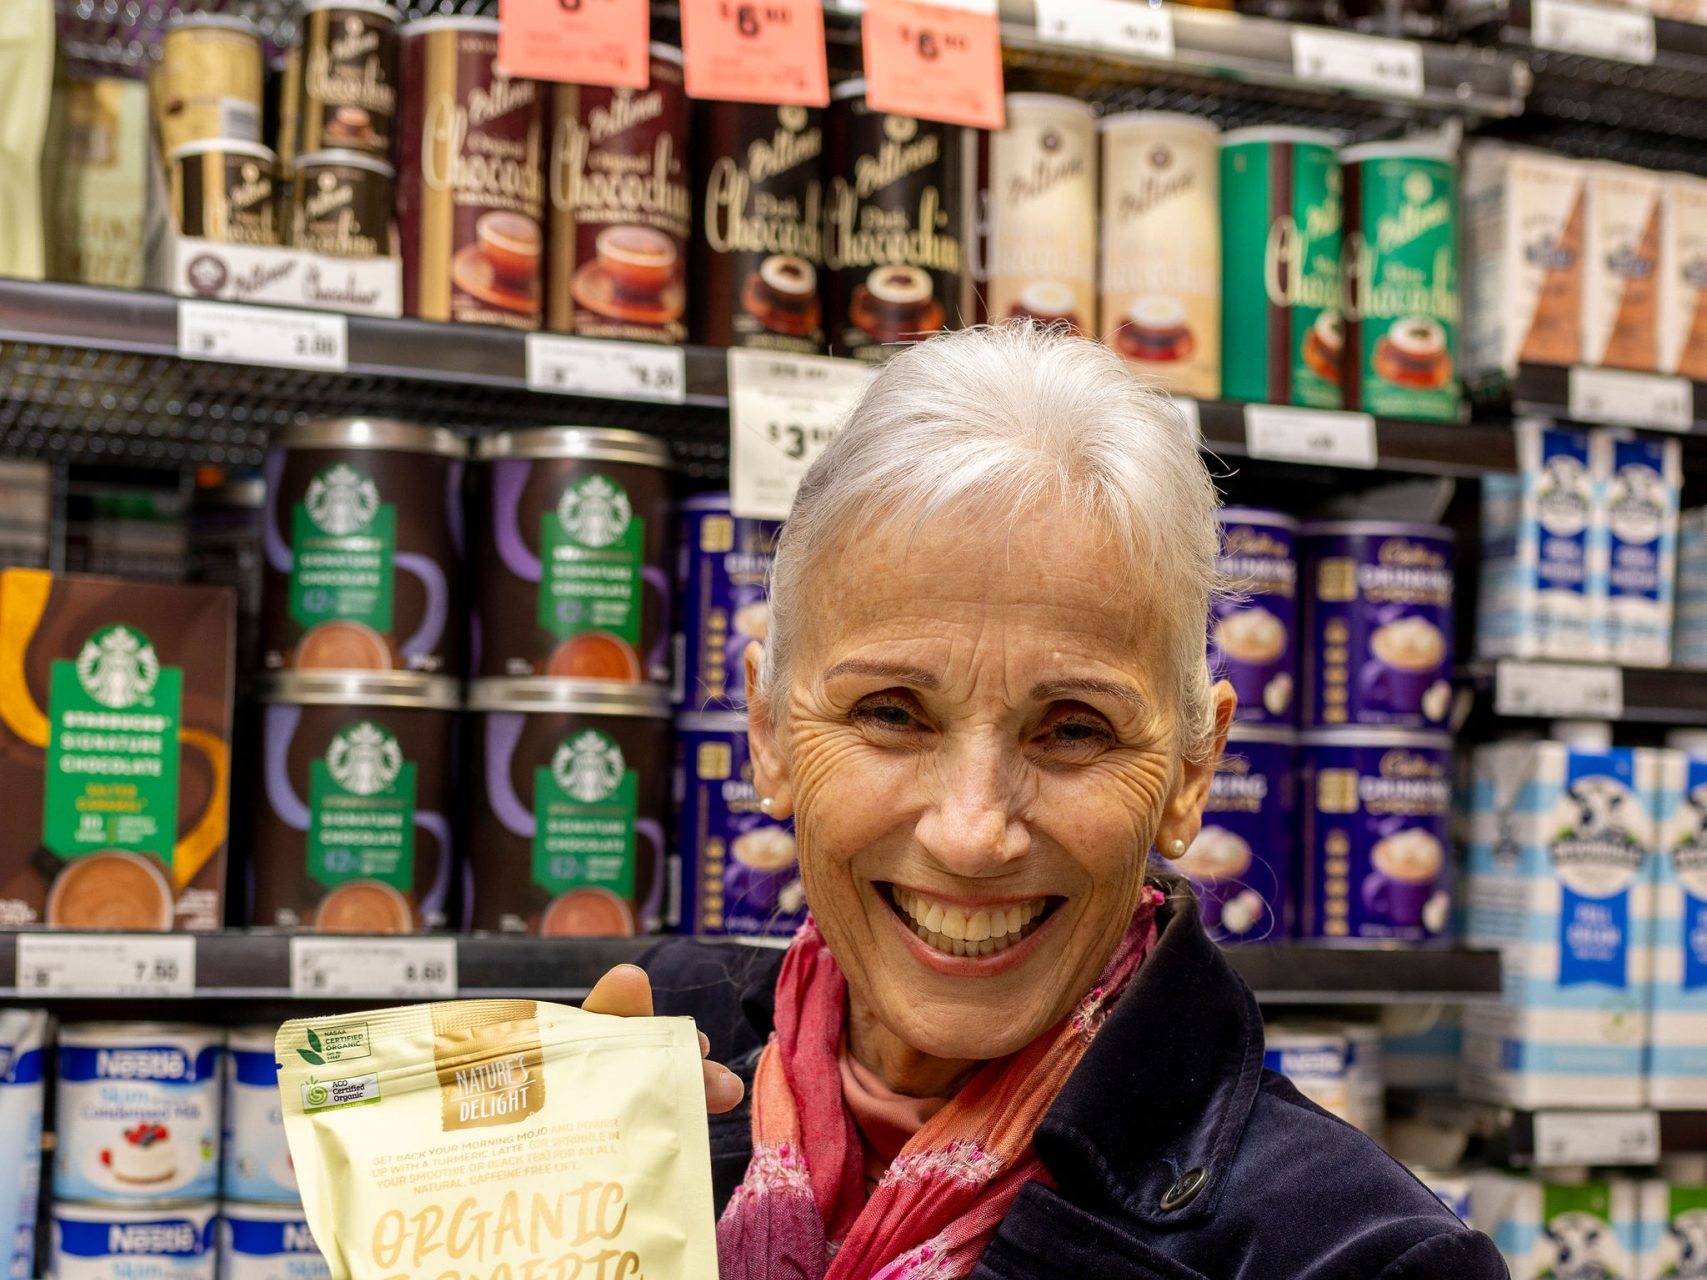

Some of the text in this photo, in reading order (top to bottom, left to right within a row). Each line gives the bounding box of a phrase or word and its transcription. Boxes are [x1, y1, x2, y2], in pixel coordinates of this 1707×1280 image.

[325, 1034, 364, 1045] CERTIFIED
[325, 1041, 361, 1052] ORGANIC
[332, 1083, 365, 1096] Certified
[456, 1054, 530, 1096] NATURE'S
[333, 1092, 363, 1103] Organic
[459, 1086, 529, 1122] DELIGHT
[390, 1162, 419, 1174] WITH
[432, 1150, 489, 1165] TURMERIC
[492, 1143, 523, 1157] LATTE
[396, 1151, 425, 1162] BACK
[428, 1144, 458, 1156] YOUR
[462, 1136, 513, 1151] MORNING
[516, 1127, 548, 1141] MOJO
[377, 1176, 406, 1189] YOUR
[410, 1166, 465, 1183] SMOOTHIE
[468, 1161, 485, 1173] OR
[487, 1155, 525, 1169] BLACK
[469, 1168, 522, 1185] CAFFEINE
[524, 1163, 552, 1176] FREE
[372, 1180, 628, 1269] ORGANIC
